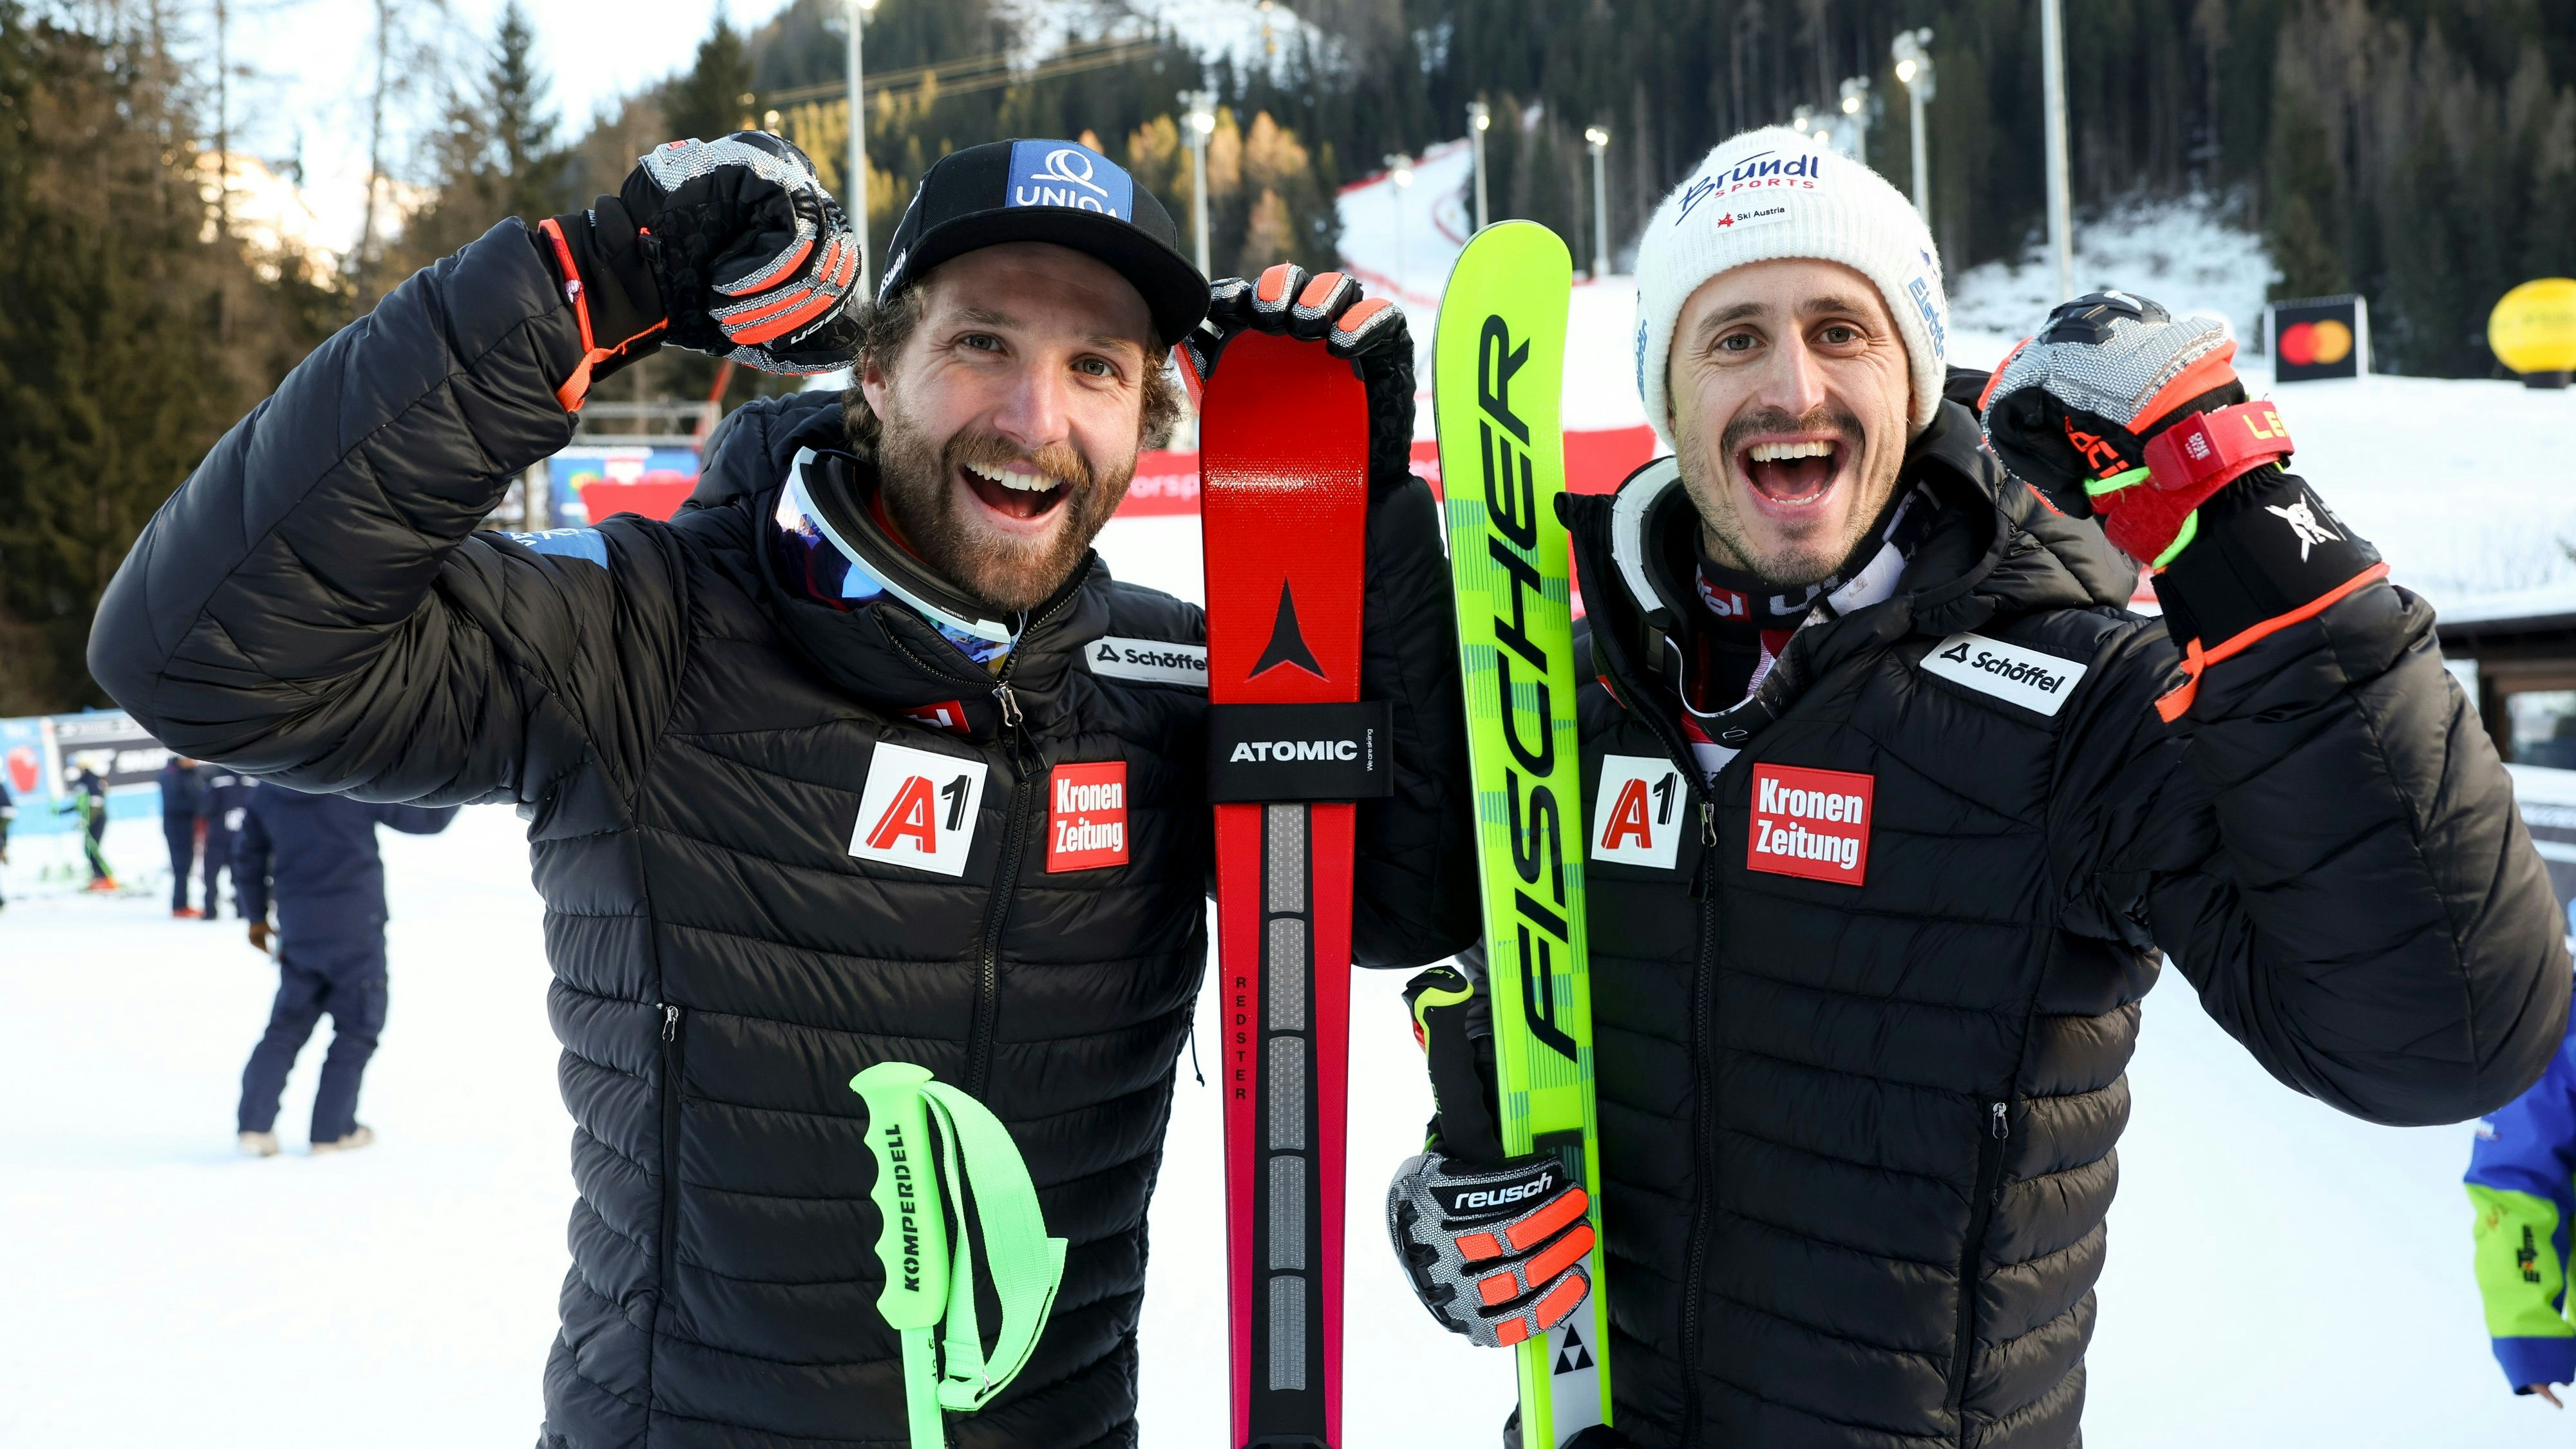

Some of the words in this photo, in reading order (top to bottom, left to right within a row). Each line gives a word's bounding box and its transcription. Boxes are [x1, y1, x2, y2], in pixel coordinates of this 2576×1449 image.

[1714, 178, 1814, 198] SPORTS
[1737, 212, 1751, 221] Ski
[1753, 207, 1785, 218] Austria
[2242, 410, 2291, 439] LE
[1478, 314, 1577, 1064] FISCHER
[1971, 651, 2066, 694] Schöffel
[1229, 740, 1358, 762] ATOMIC
[1367, 760, 1373, 772] We
[866, 774, 972, 853] A1
[1057, 778, 1122, 814] Kronen
[1601, 772, 1678, 850] A1
[1758, 778, 1864, 824] Kronen
[1054, 817, 1124, 853] Zeitung
[1756, 821, 1860, 870] Zeitung
[1236, 976, 1247, 1100] REDSTER
[885, 1124, 920, 1293] KOMPERDELL
[1454, 1171, 1553, 1209] reusch
